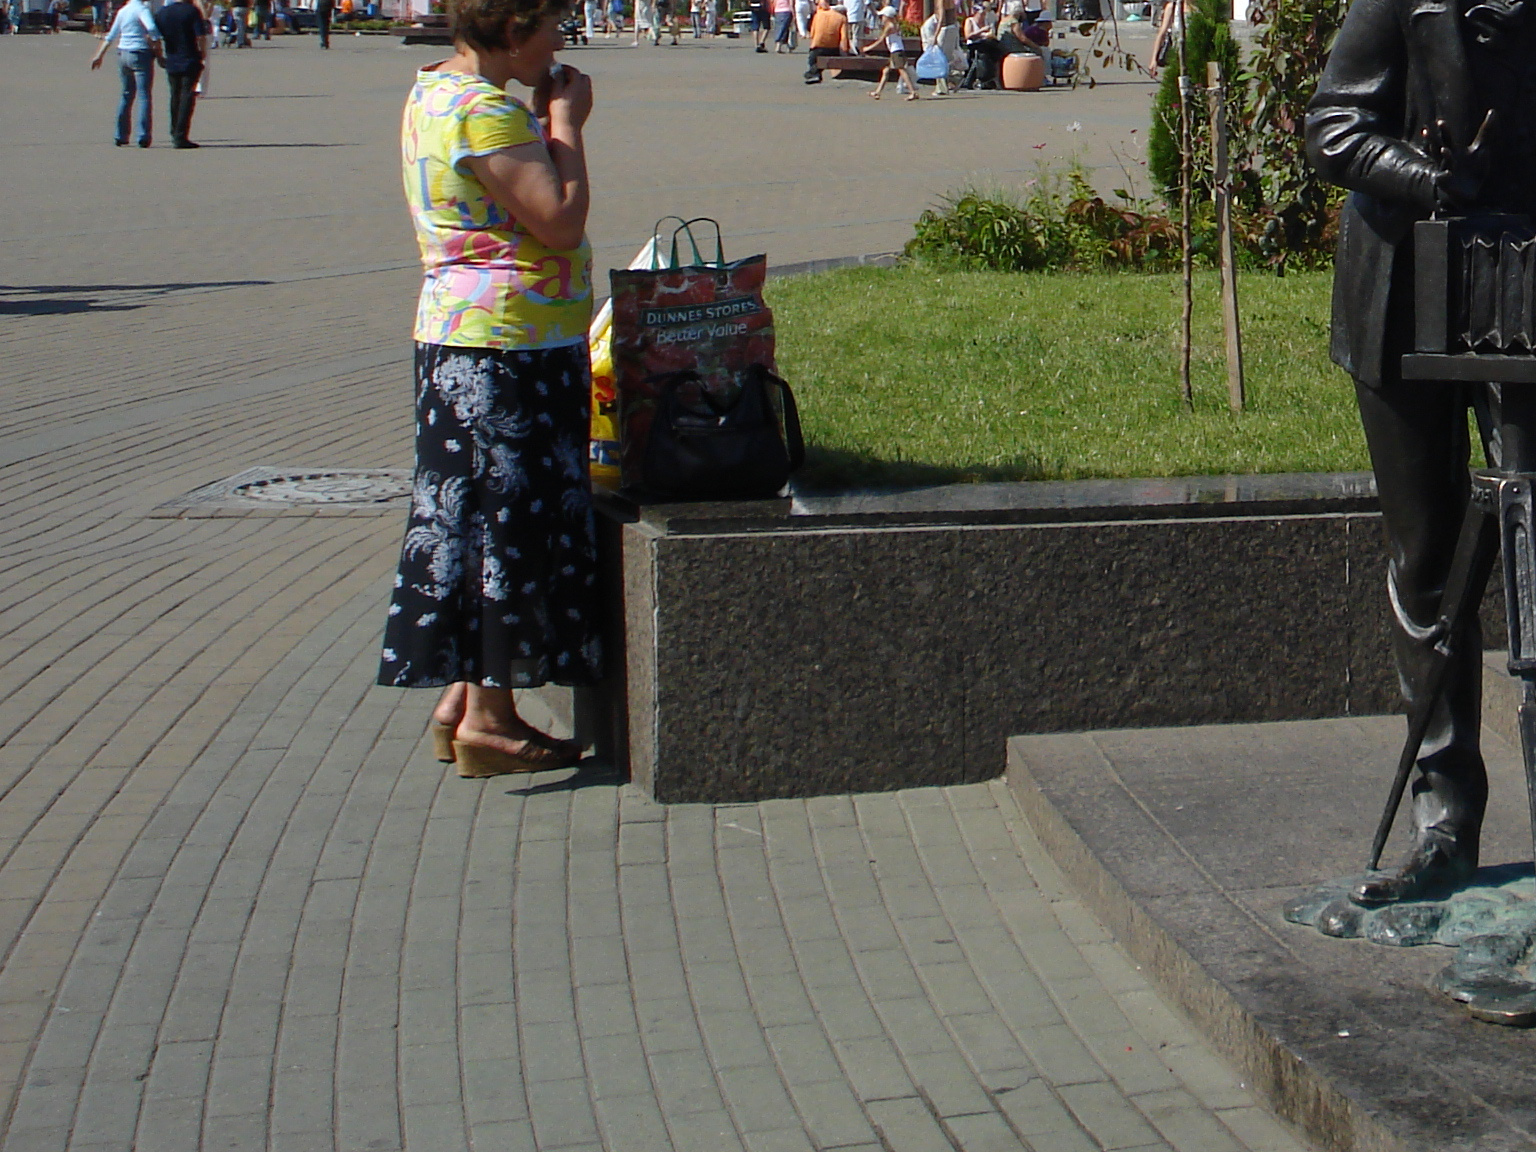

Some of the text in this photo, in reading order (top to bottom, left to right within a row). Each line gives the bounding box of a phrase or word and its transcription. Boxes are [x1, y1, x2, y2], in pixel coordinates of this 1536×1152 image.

[646, 300, 757, 325] DUNNES STORES
[656, 322, 748, 345] Better Value
